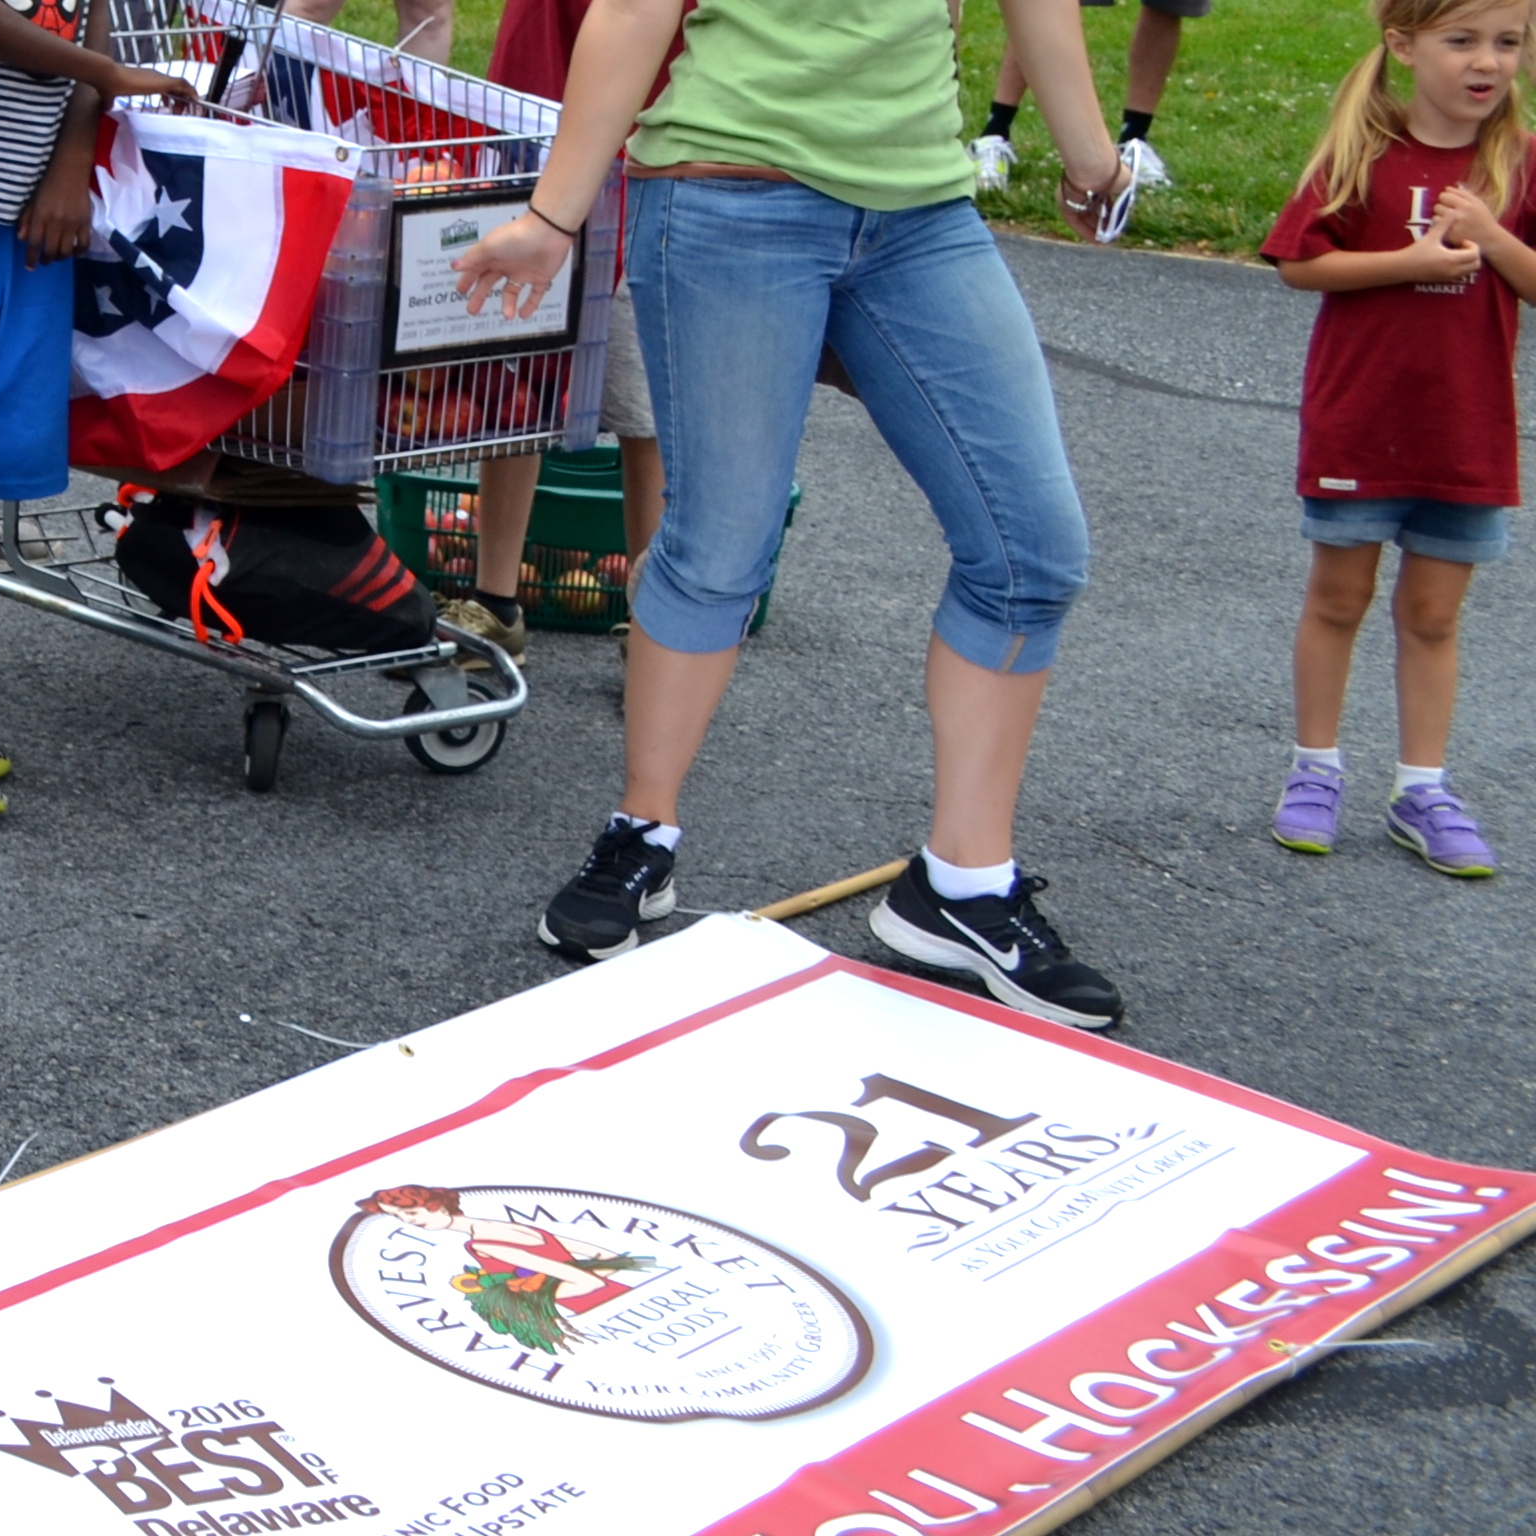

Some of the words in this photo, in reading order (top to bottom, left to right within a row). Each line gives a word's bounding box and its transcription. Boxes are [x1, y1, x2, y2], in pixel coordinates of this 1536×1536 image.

[409, 295, 432, 308] Best
[435, 292, 448, 304] Of
[1414, 284, 1466, 295] MARKET
[739, 1073, 1042, 1202] 21
[879, 1123, 1121, 1231] YEARS
[377, 1226, 566, 1383] HARVEST
[502, 1204, 798, 1294] MARKET
[582, 1281, 720, 1345] NATURAL
[585, 1380, 672, 1397] YOUR
[679, 1354, 813, 1399] COMMUNITY
[793, 1301, 822, 1354] GROCER
[633, 1305, 729, 1354] FOODS
[168, 1399, 266, 1428] 2016
[60, 1421, 325, 1516] BEST
[438, 1472, 524, 1517] FOOD
